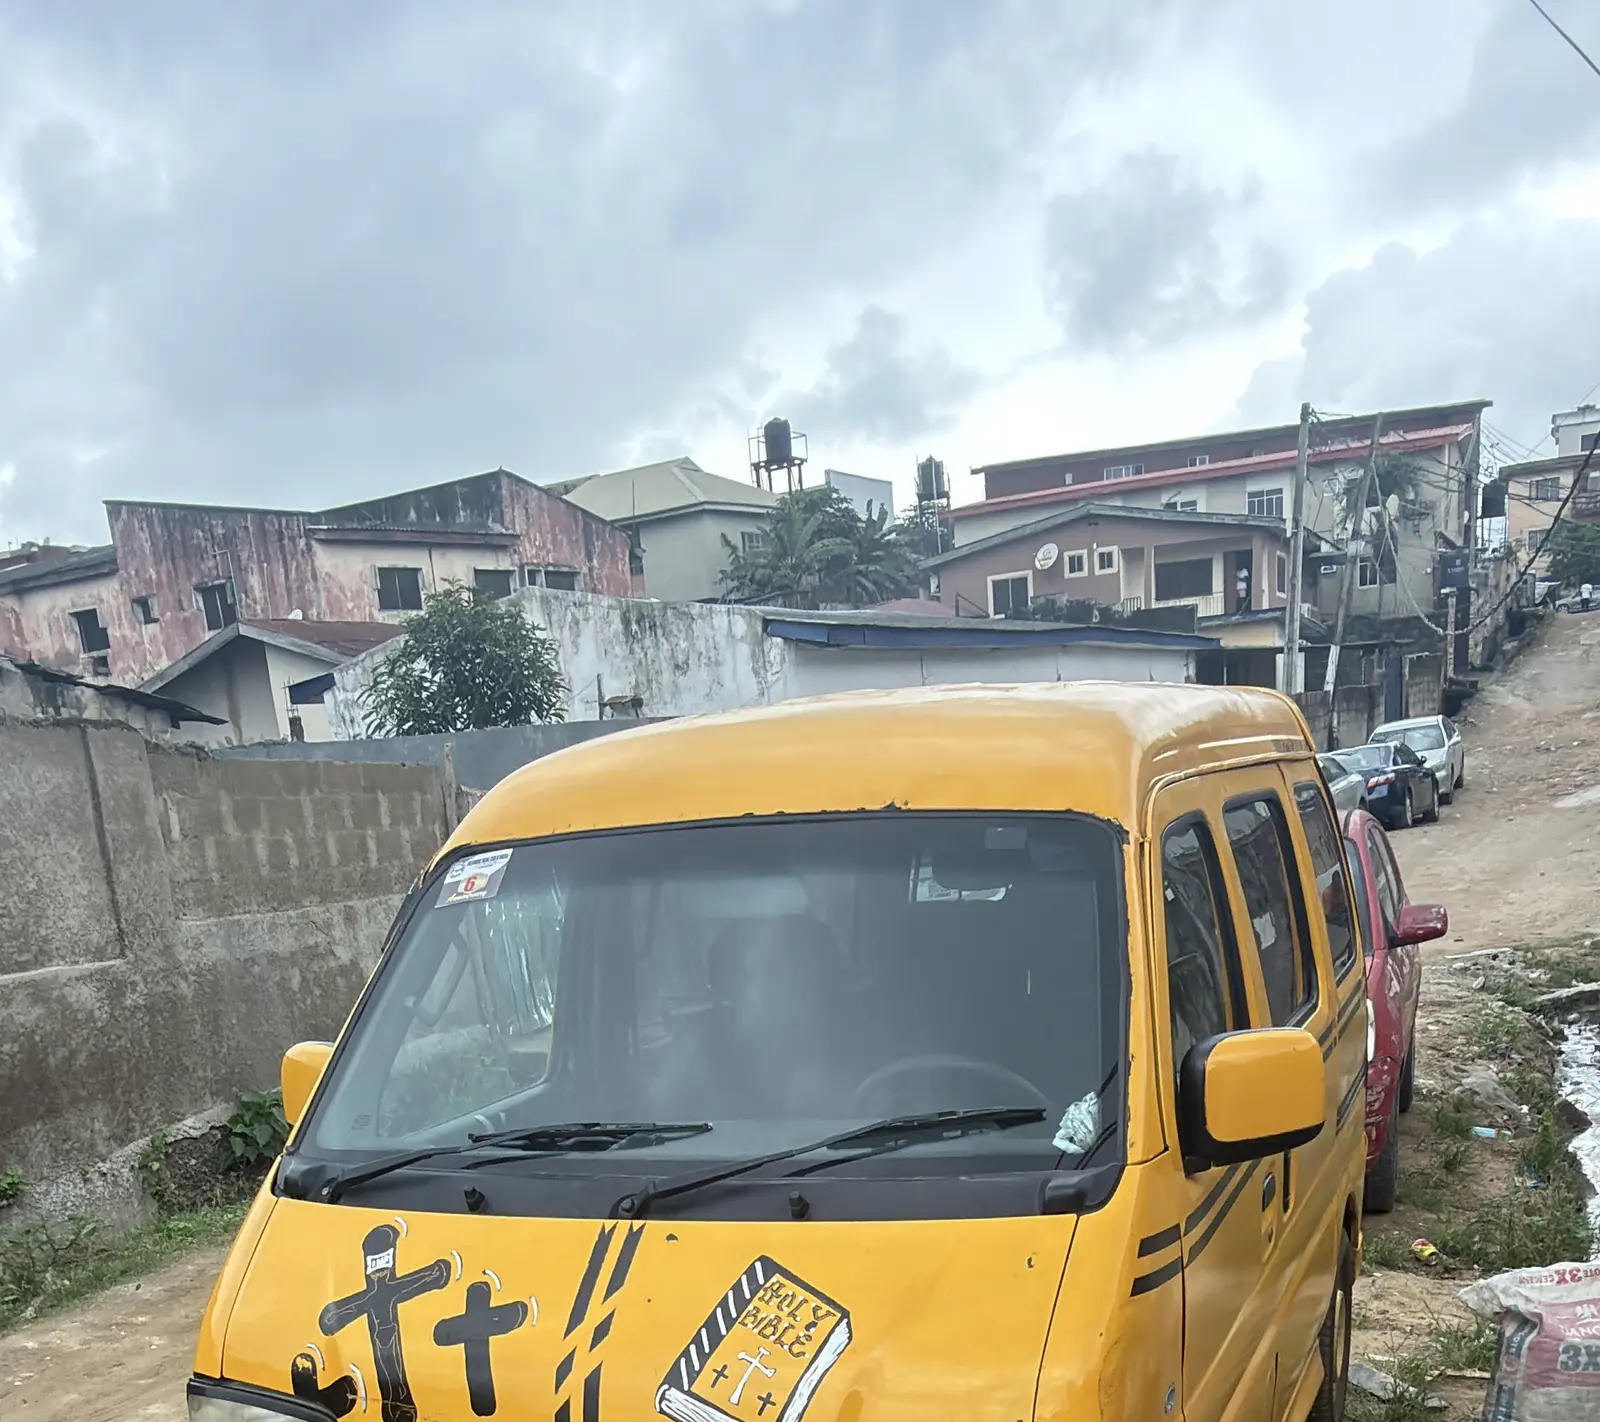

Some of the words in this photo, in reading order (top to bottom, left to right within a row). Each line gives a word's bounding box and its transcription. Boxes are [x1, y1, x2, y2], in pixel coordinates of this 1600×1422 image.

[1554, 1266, 1582, 1286] 3X
[738, 1305, 813, 1358] BIBLE
[758, 1280, 836, 1332] HOLY
